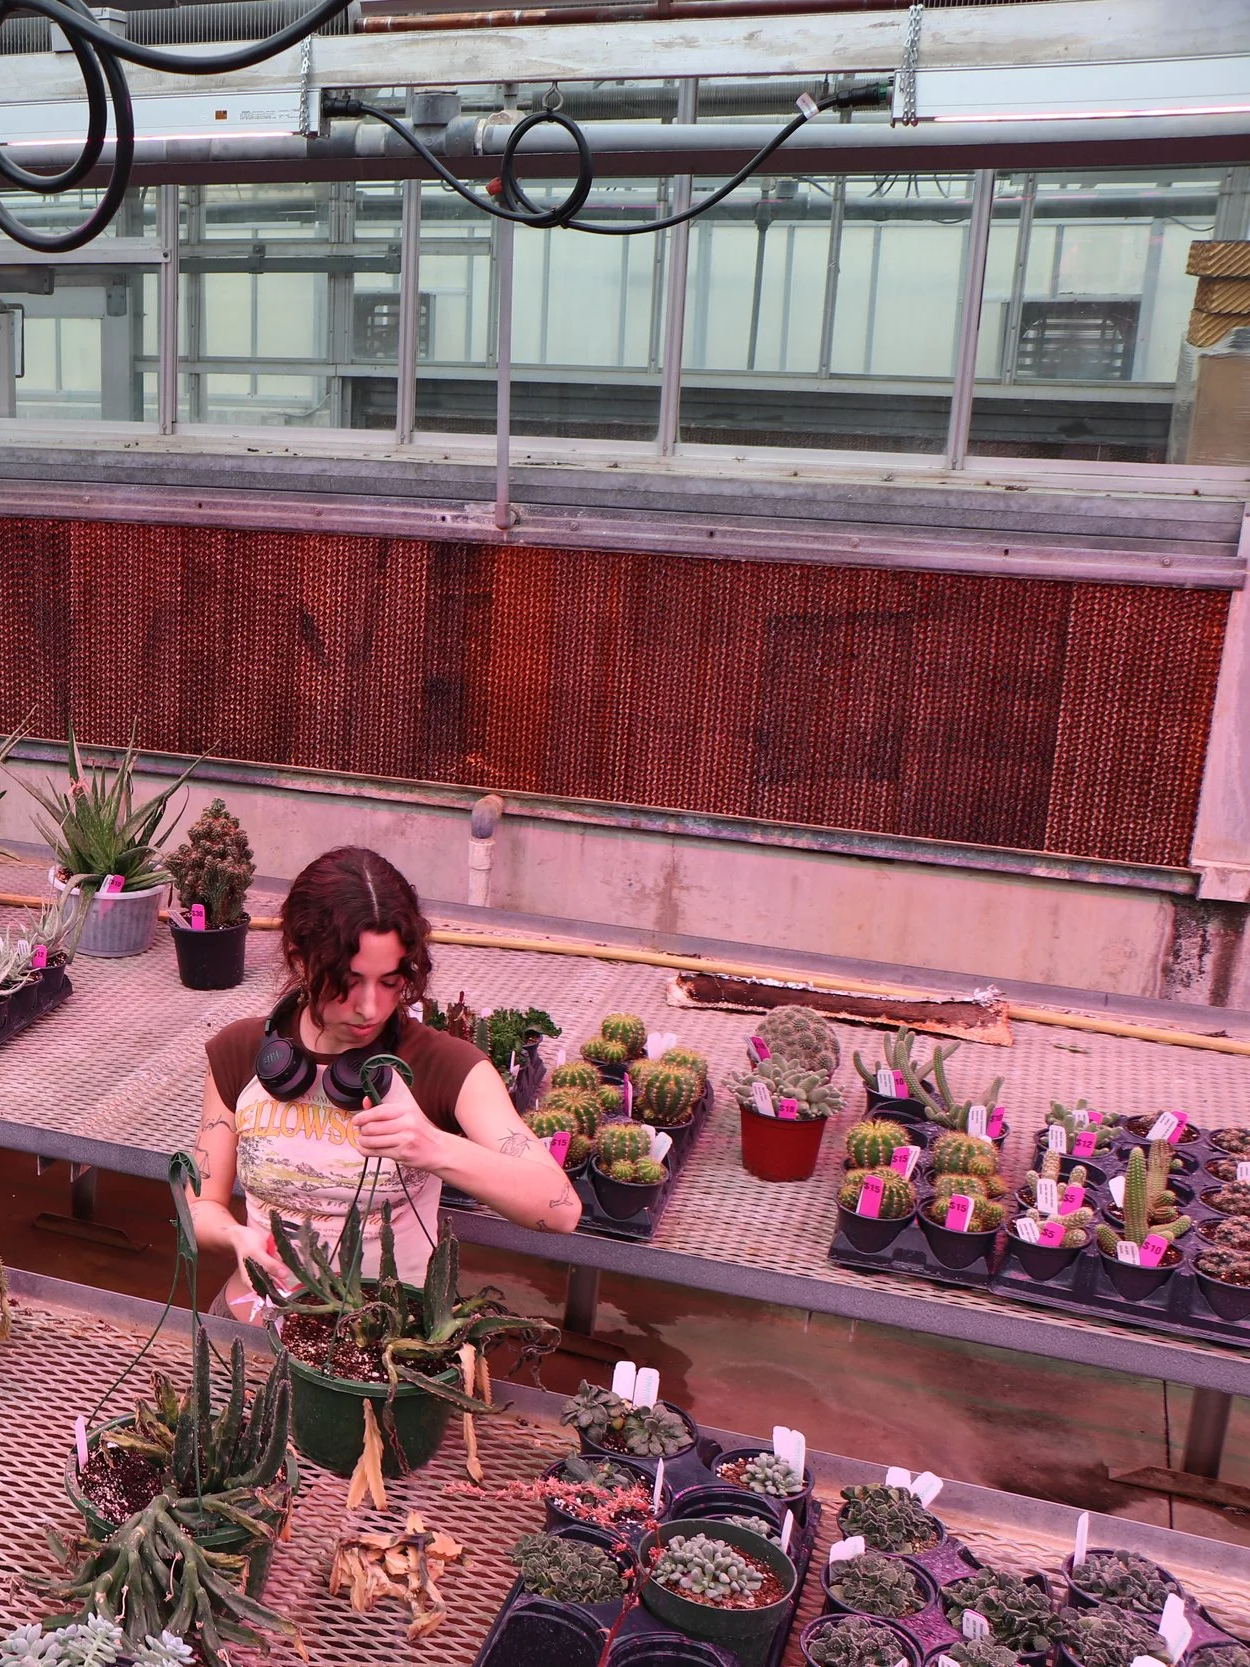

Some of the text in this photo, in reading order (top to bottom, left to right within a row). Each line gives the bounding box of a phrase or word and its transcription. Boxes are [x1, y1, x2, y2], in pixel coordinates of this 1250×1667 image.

[1075, 1138, 1092, 1148] $12
[892, 1154, 908, 1163] $15
[864, 1182, 880, 1194] $15
[1063, 1193, 1075, 1203] $5
[949, 1202, 967, 1213] $15
[1042, 1228, 1054, 1239] $5
[1143, 1241, 1162, 1255] $10
